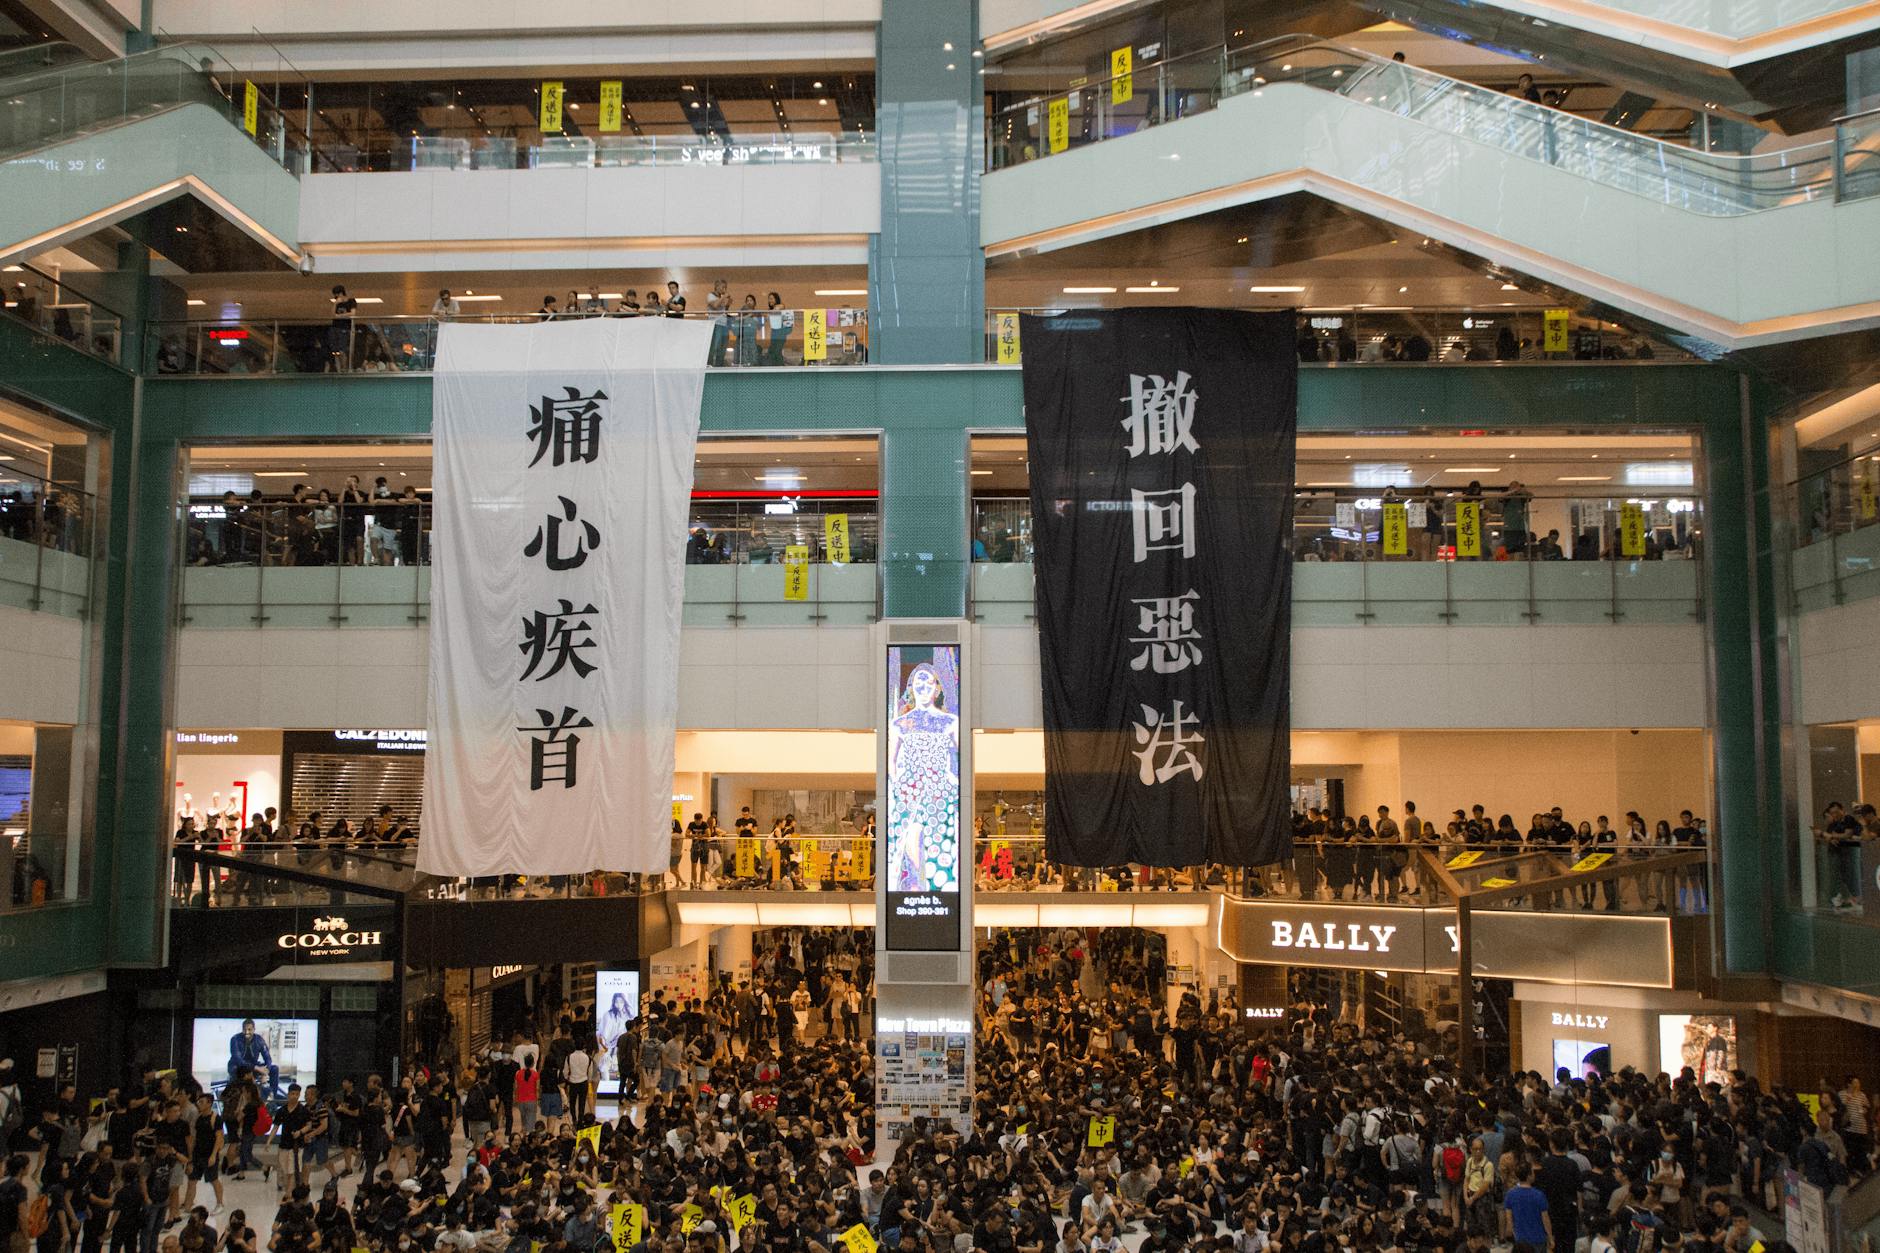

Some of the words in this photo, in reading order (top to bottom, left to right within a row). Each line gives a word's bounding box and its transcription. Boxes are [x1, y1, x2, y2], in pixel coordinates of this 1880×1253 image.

[546, 87, 557, 127] 反送中
[809, 312, 821, 354] 反送中
[1002, 316, 1015, 359] 反送中
[831, 519, 844, 563] 反送中
[1461, 506, 1475, 551] 反送中
[516, 386, 609, 791] 痛心疾首
[792, 567, 801, 597] 反送中
[1119, 370, 1206, 786] 撤回惡法
[198, 733, 239, 744] lingerie
[377, 742, 401, 750] ITALIAN
[896, 907, 917, 916] Shop
[904, 896, 931, 906] agnès
[932, 896, 942, 904] b.
[278, 931, 381, 948] COACH
[1271, 921, 1396, 952] BALLY
[878, 1018, 905, 1032] New
[906, 1018, 937, 1032] Town
[938, 1018, 971, 1032] Plaza
[1246, 1008, 1284, 1017] BALLY
[1552, 1012, 1608, 1029] BALLY
[618, 1208, 636, 1253] 反送
